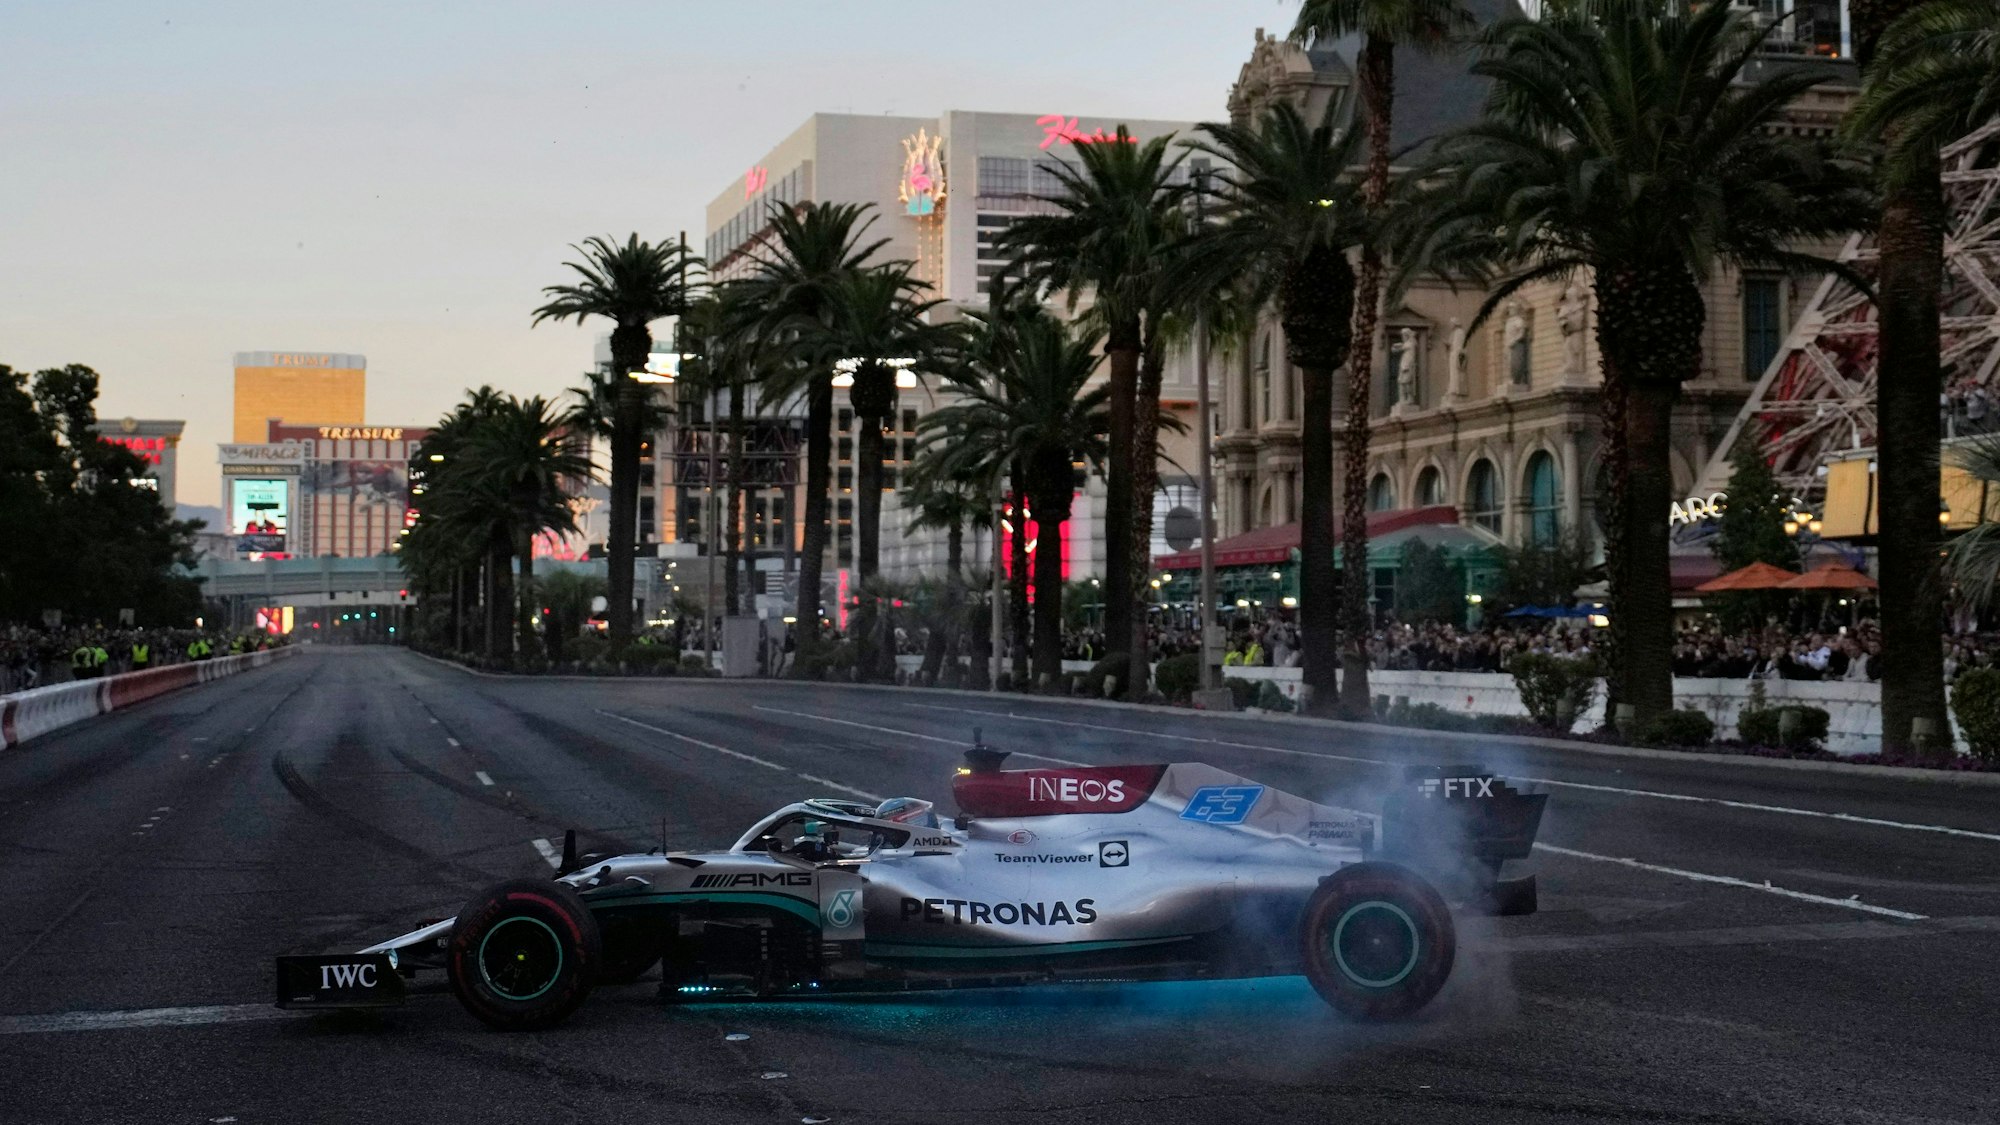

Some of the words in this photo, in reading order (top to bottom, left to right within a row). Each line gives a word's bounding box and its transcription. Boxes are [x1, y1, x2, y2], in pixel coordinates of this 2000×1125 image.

[319, 426, 403, 441] TREASURE
[1029, 777, 1126, 803] INEOS
[1444, 777, 1494, 798] FTX
[1179, 785, 1265, 825] 63
[913, 836, 941, 847] AMD
[995, 853, 1094, 864] TeamViewer
[729, 873, 812, 887] AMG
[901, 897, 1098, 926] PETRONAS
[320, 963, 378, 989] IWC
